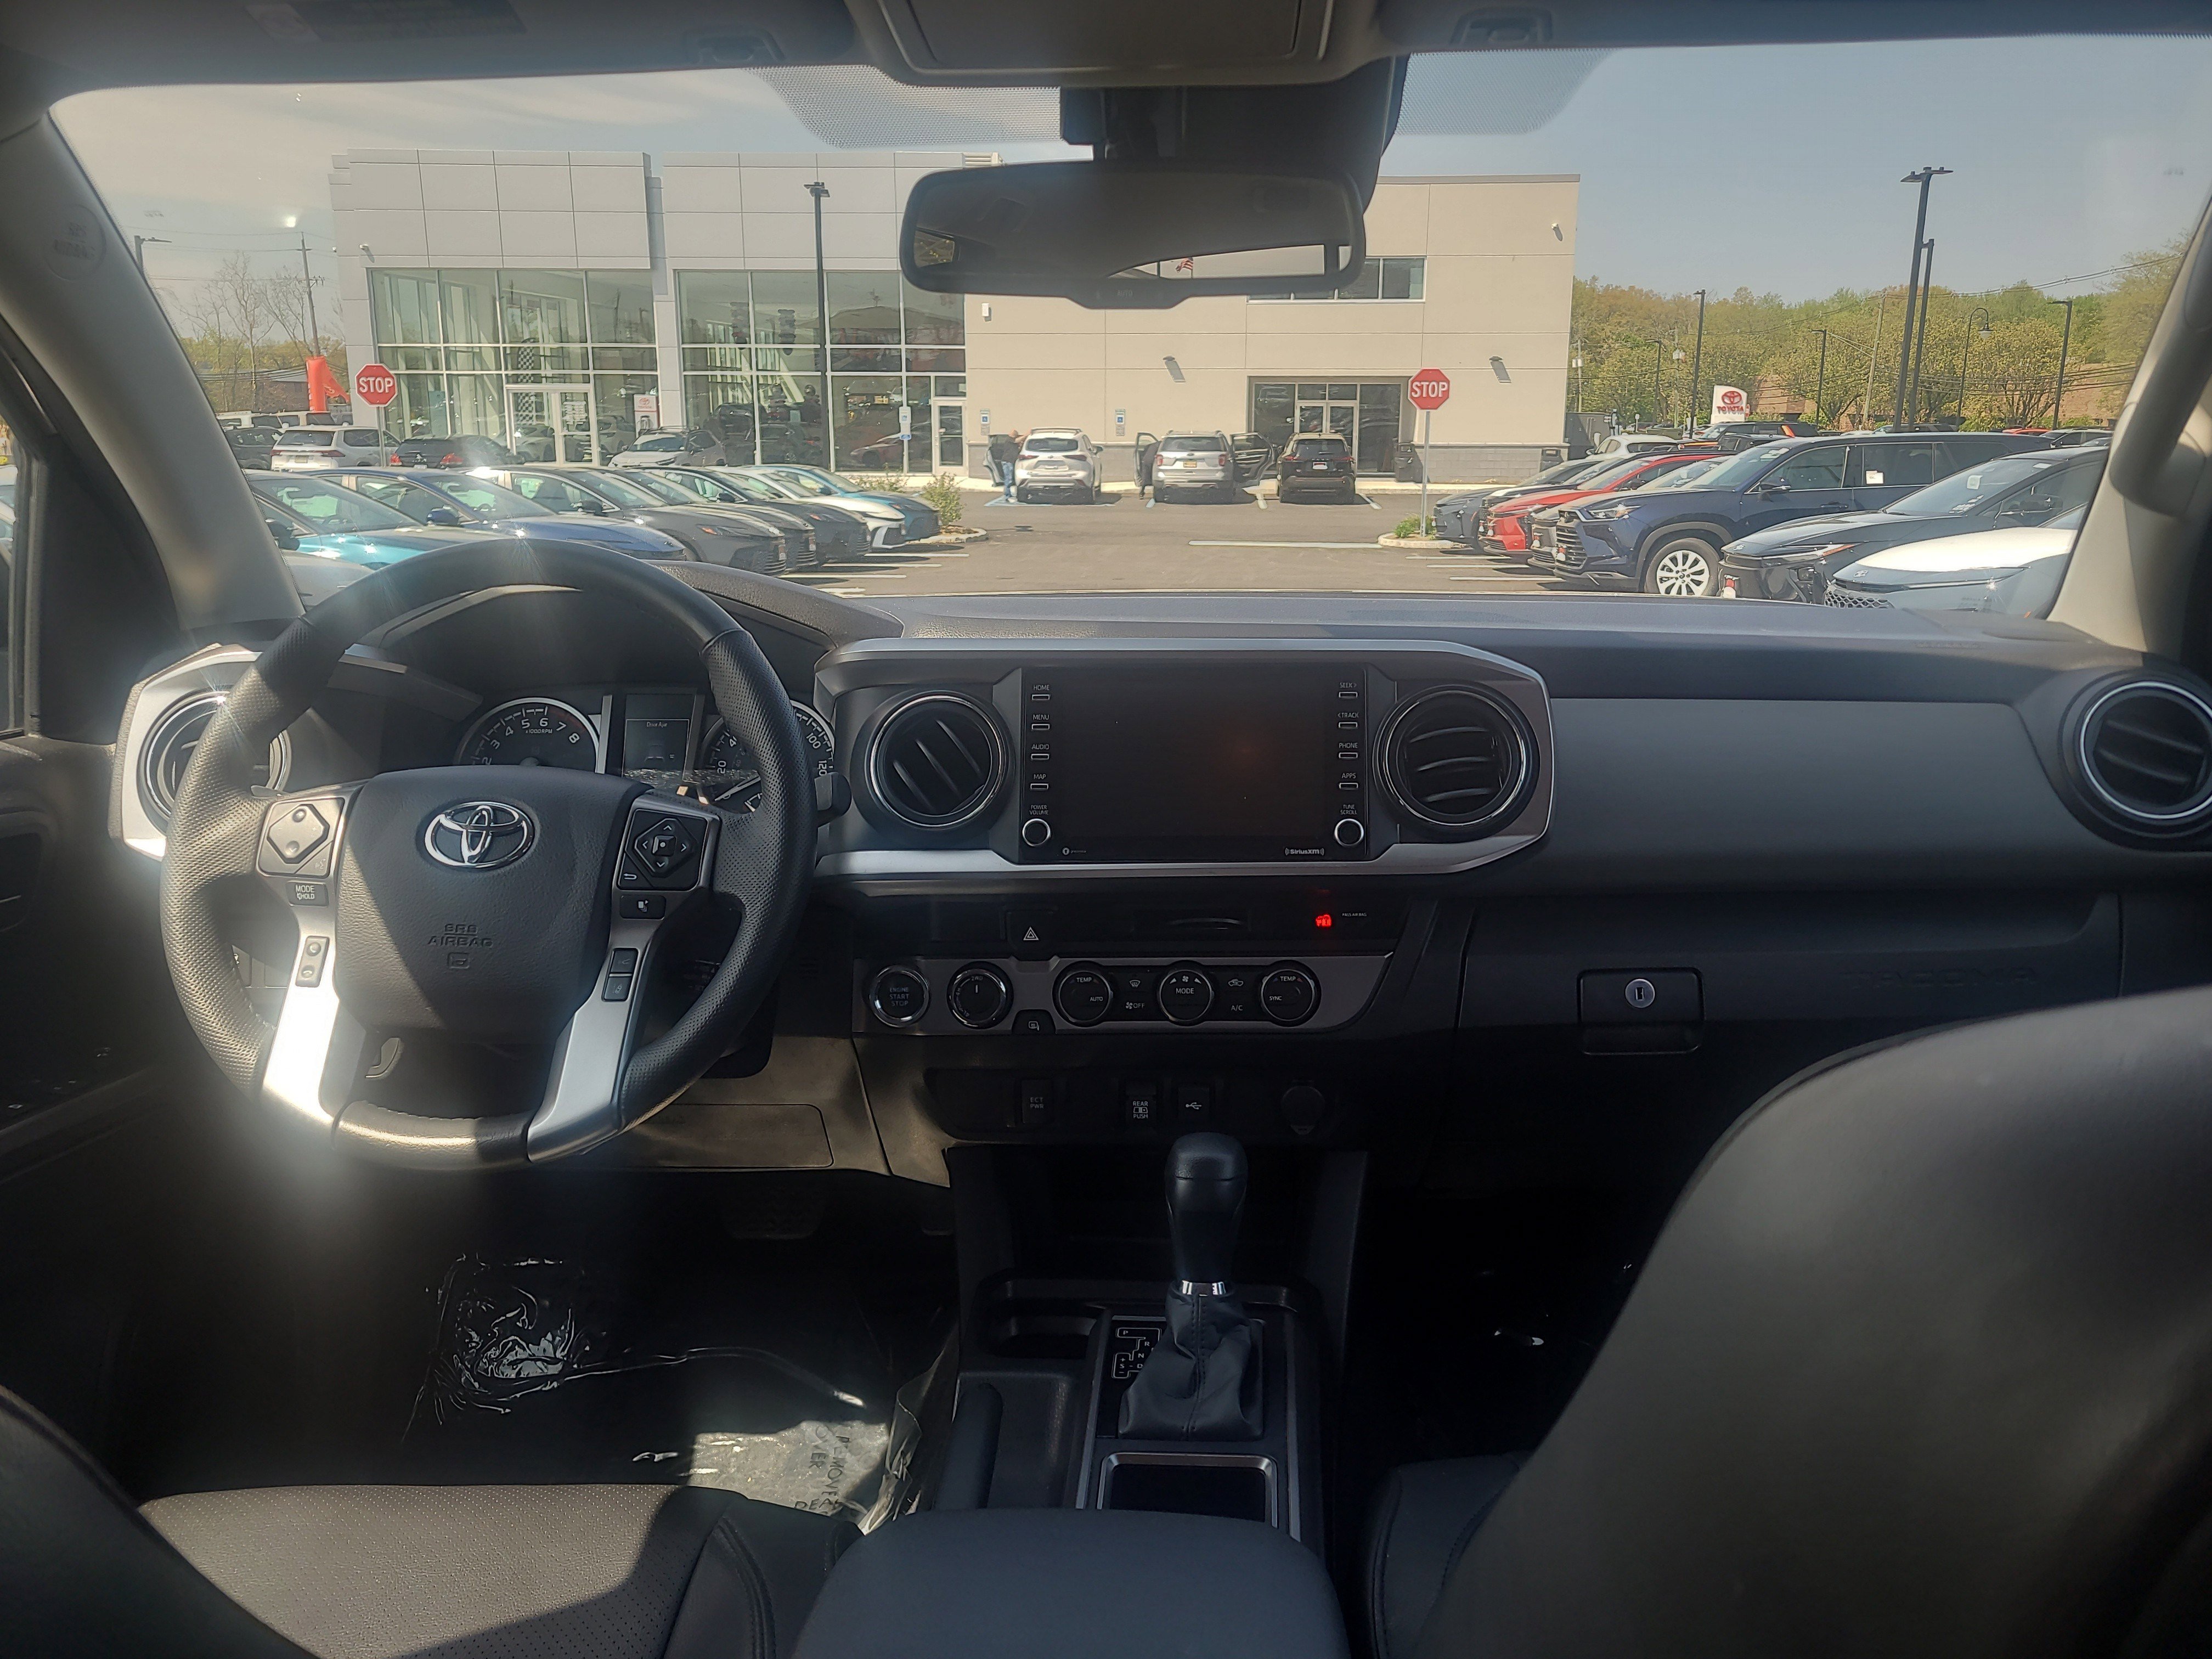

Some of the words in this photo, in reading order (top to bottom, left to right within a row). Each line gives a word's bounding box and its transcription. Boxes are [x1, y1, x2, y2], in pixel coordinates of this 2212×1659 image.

[359, 376, 394, 393] STOP
[1411, 381, 1448, 398] STOP
[521, 719, 531, 729] 5
[539, 718, 549, 727] 6
[556, 721, 567, 731] 7
[505, 726, 514, 736] 4
[568, 733, 580, 744] 8
[806, 732, 821, 749] 100
[490, 740, 500, 749] 3
[482, 757, 492, 765] 2
[717, 760, 726, 774] 20
[818, 760, 827, 776] 120
[295, 885, 315, 893] MODE
[444, 923, 478, 933] SRS
[427, 935, 493, 947] AIRBAG
